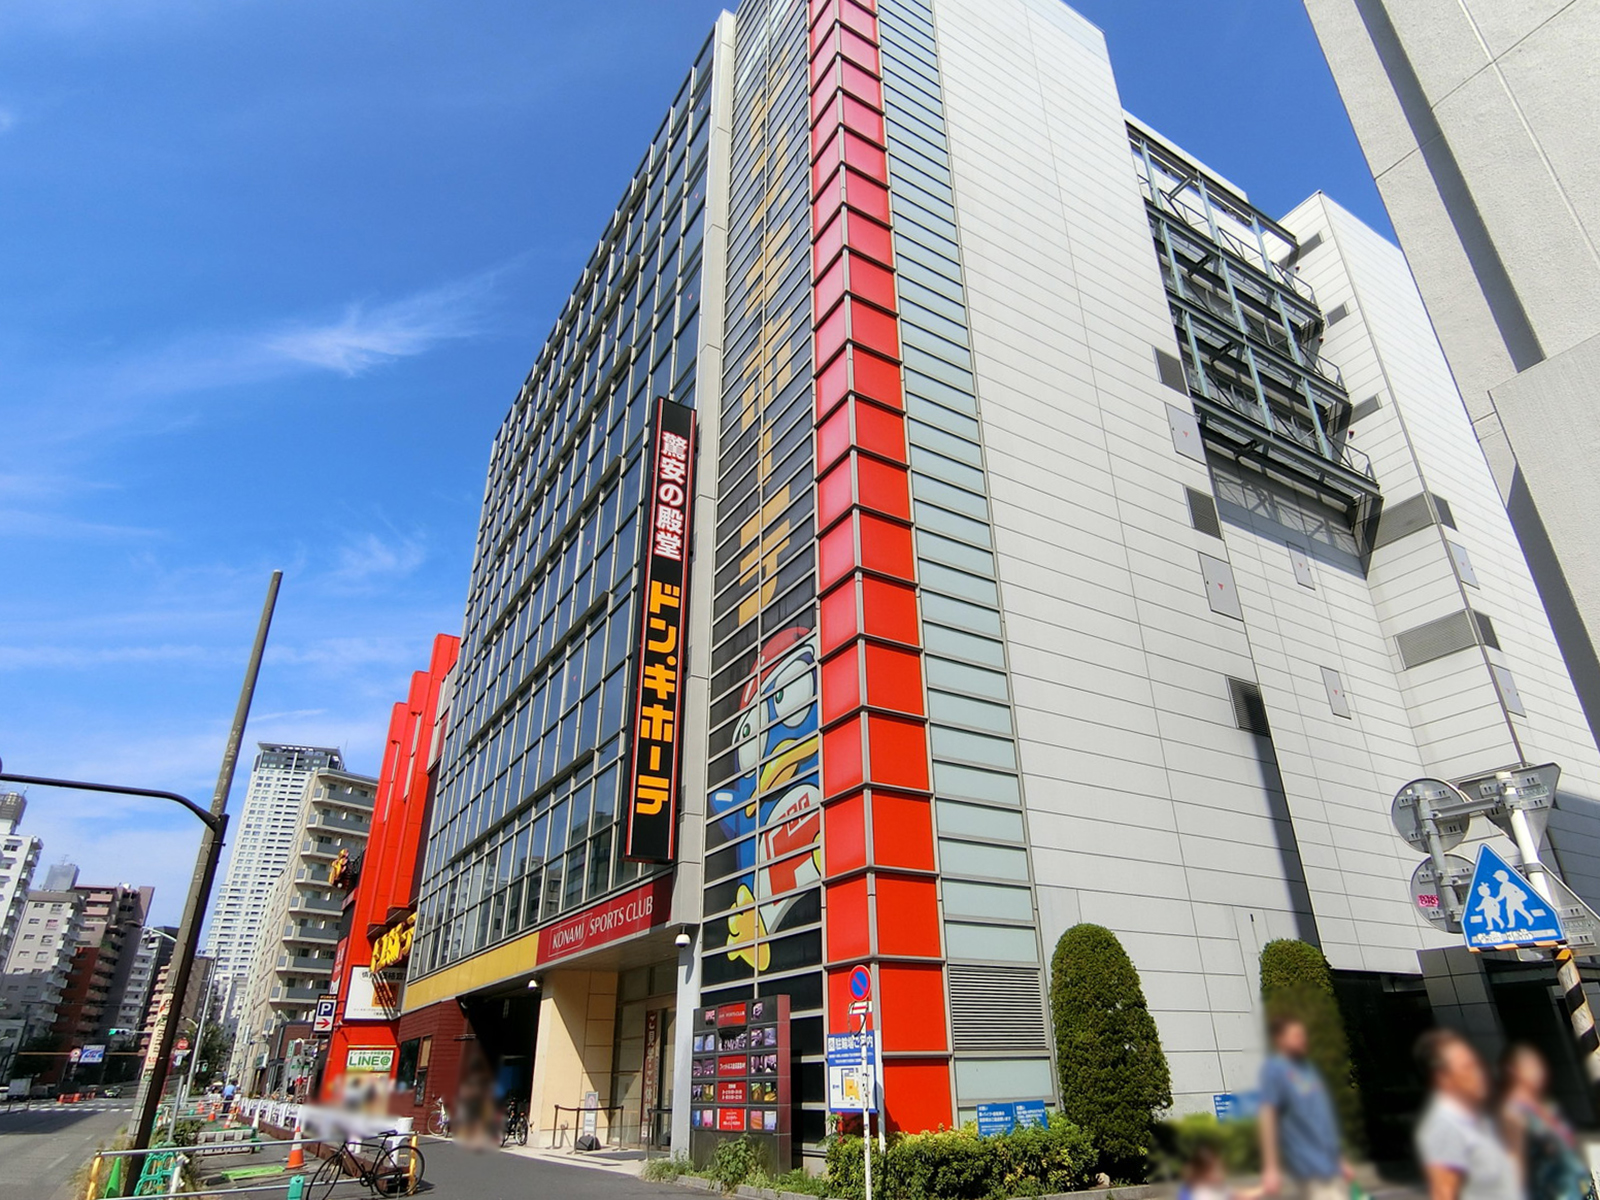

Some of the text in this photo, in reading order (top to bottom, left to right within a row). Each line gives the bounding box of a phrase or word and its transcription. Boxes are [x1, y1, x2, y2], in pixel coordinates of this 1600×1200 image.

[653, 430, 688, 562] 驚安の殿堂
[552, 895, 653, 949] KONAMI SPORTS CLUB
[320, 1003, 332, 1015] P
[349, 1055, 391, 1066] LINE@
